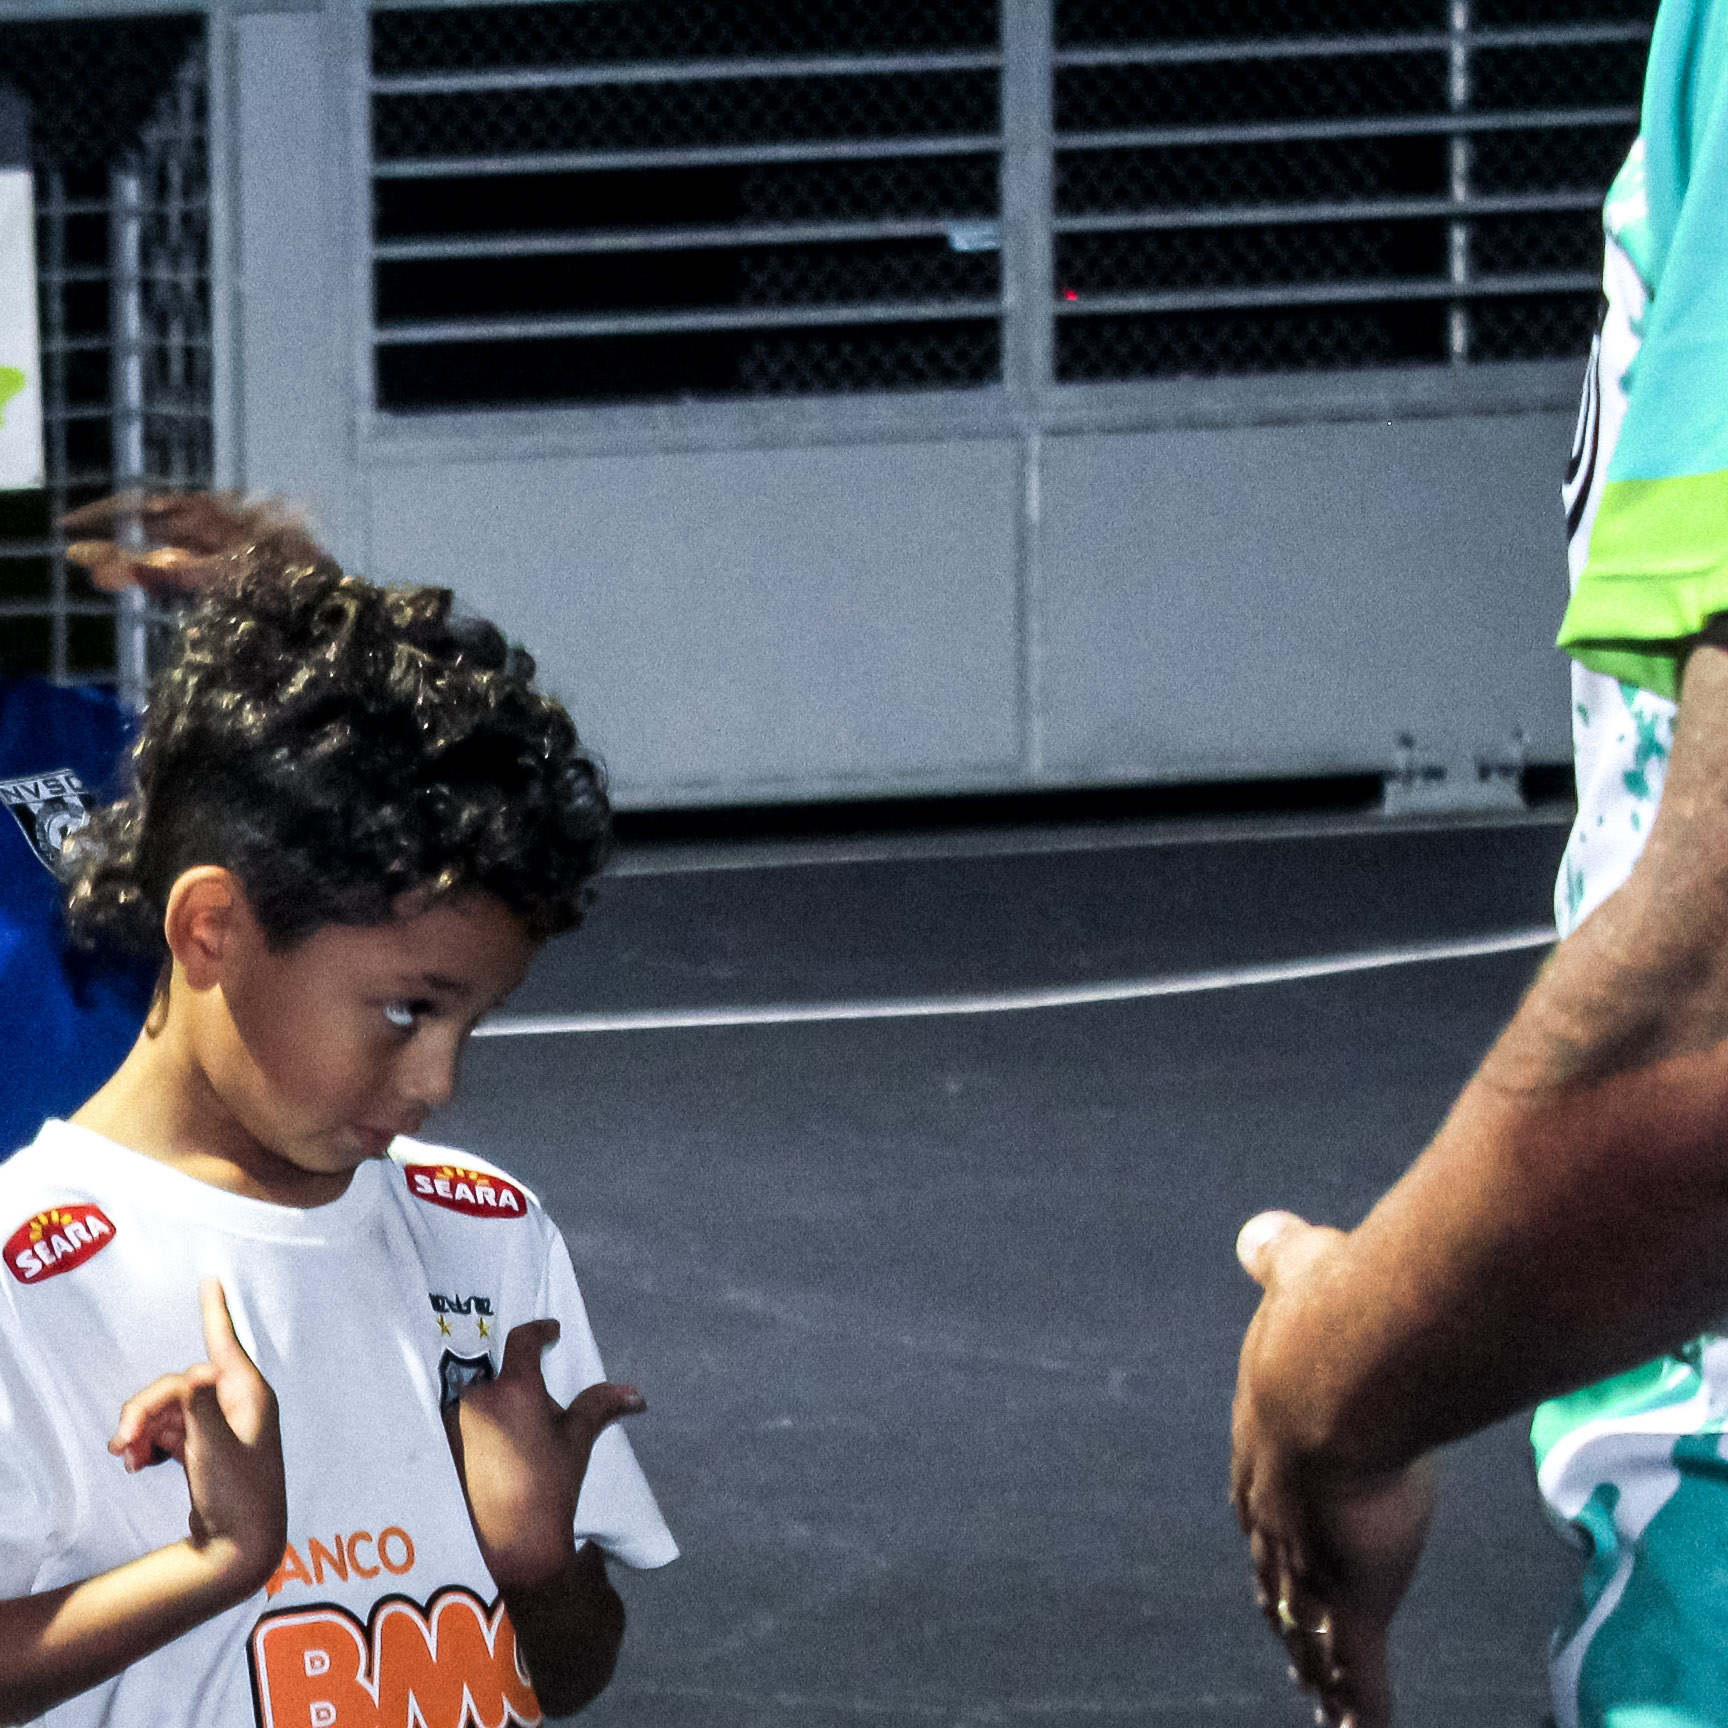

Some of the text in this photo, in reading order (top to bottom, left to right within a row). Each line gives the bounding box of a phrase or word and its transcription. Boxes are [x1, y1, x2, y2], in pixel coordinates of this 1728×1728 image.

[414, 1173, 520, 1212] SEARA
[14, 1214, 111, 1279] SEARA
[264, 1525, 416, 1598] ANCO
